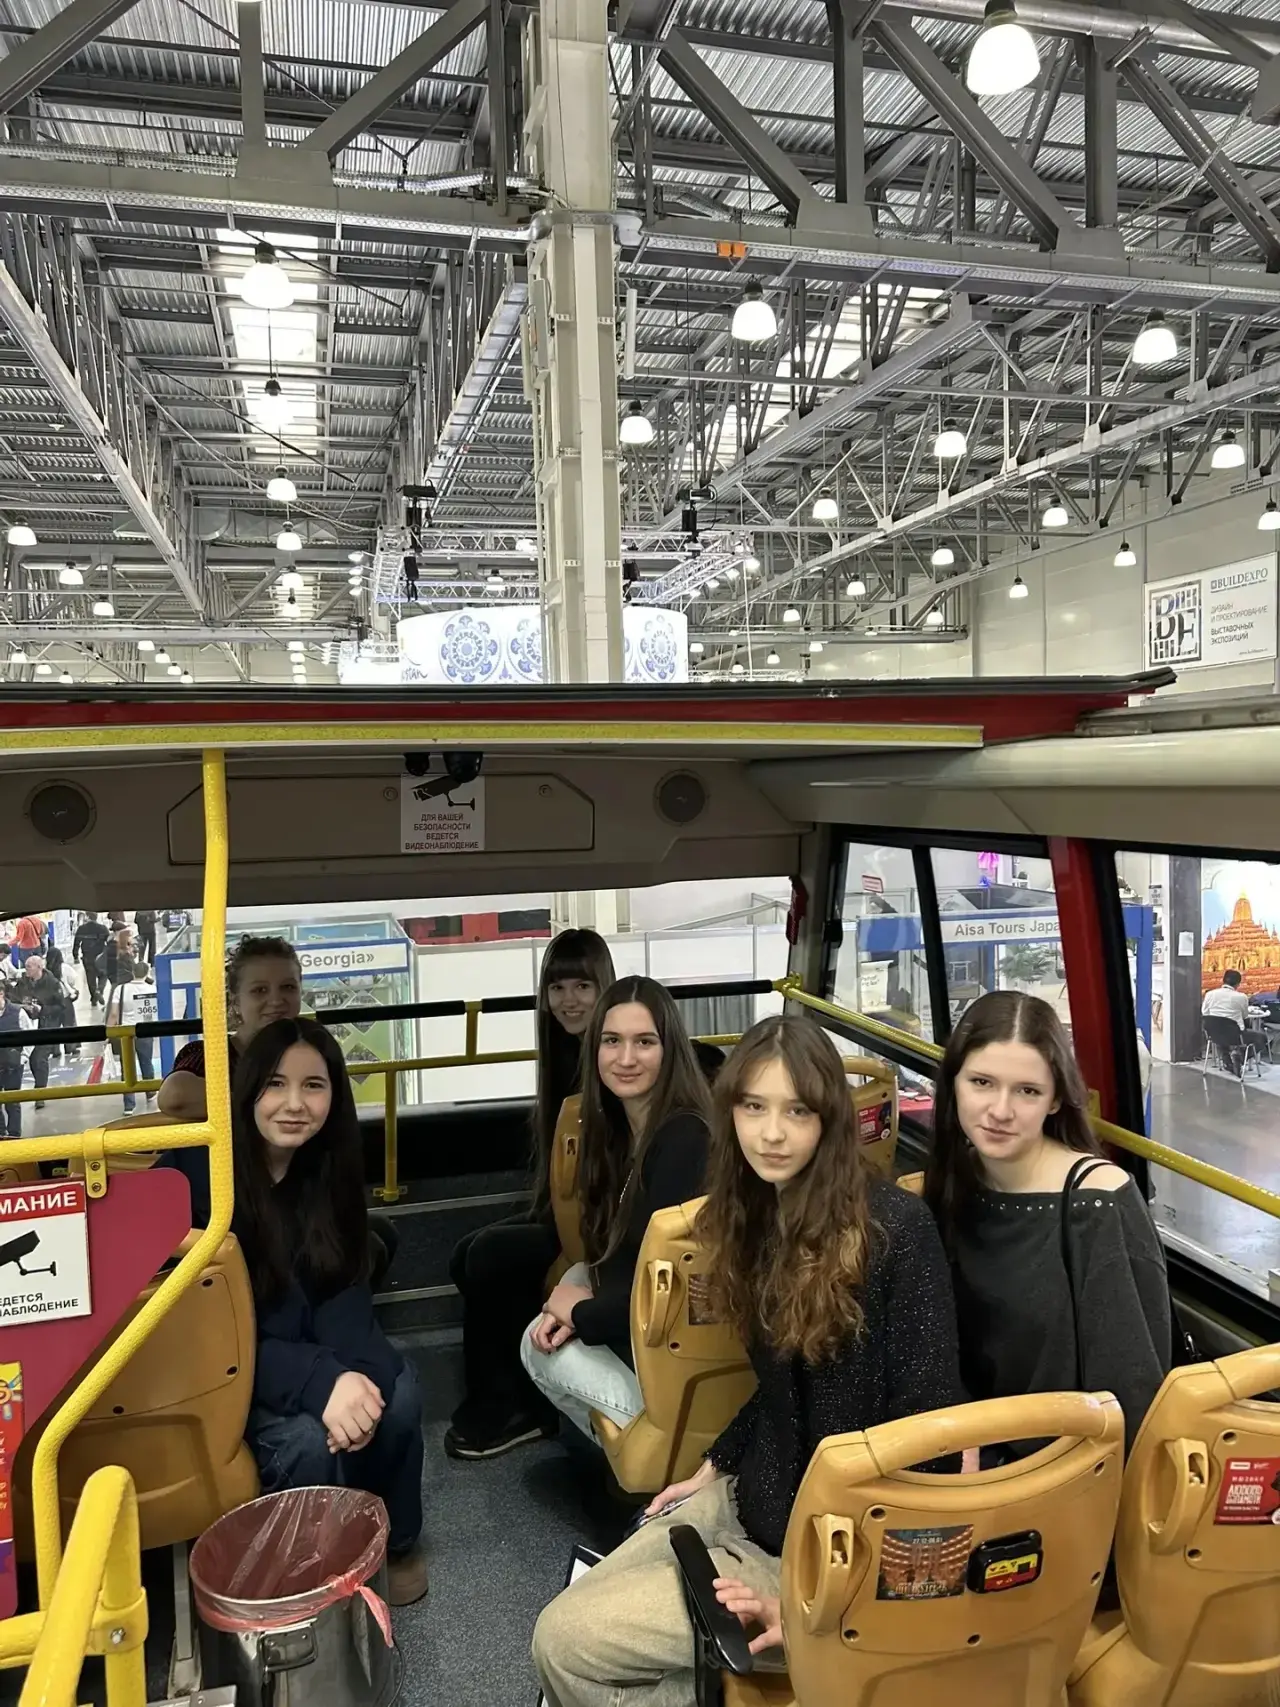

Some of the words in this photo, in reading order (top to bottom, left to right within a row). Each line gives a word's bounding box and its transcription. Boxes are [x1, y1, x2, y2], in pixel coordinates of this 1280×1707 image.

[1218, 568, 1268, 588] BUILDEXPO
[1211, 622, 1254, 636] ВЫСТАВОЧНЫХ
[1211, 631, 1249, 645] ЭКСПОЗИЦИЙ
[421, 814, 436, 822] ДЛЯ
[438, 813, 464, 821] ВАШЕЙ
[414, 823, 471, 831] БЕЗОПАСНОСТИ
[405, 842, 479, 850] ВИДЕОНАБЛЮДЕНИЕ
[955, 924, 985, 936] Aisa
[988, 922, 1026, 934] Tours
[0, 1298, 79, 1317] АБЛЮДЕНИЕ
